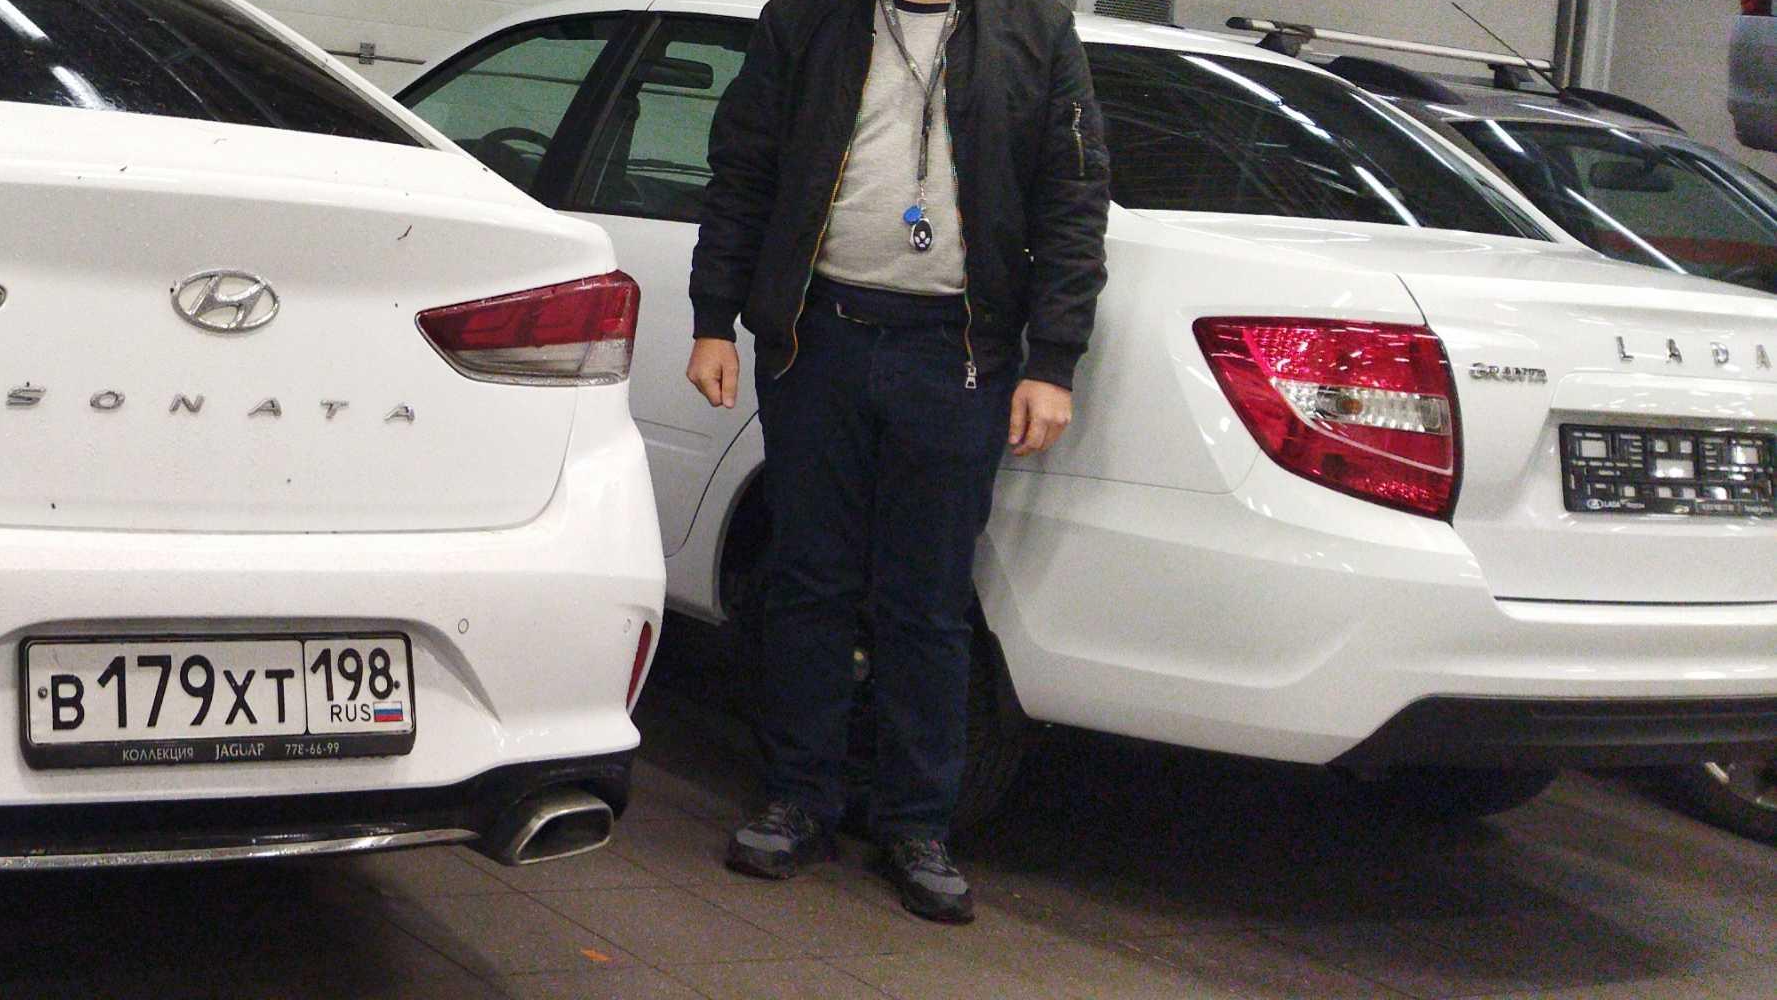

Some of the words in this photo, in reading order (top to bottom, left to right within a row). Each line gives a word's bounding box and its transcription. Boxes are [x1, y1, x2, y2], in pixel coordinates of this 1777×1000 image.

[1613, 335, 1771, 370] LADA
[6, 385, 416, 425] SONATA
[50, 654, 295, 731] В179ХТ
[309, 647, 395, 702] 198
[329, 703, 372, 723] RUS
[122, 747, 195, 762] КОЛЛЕКЦИЯ
